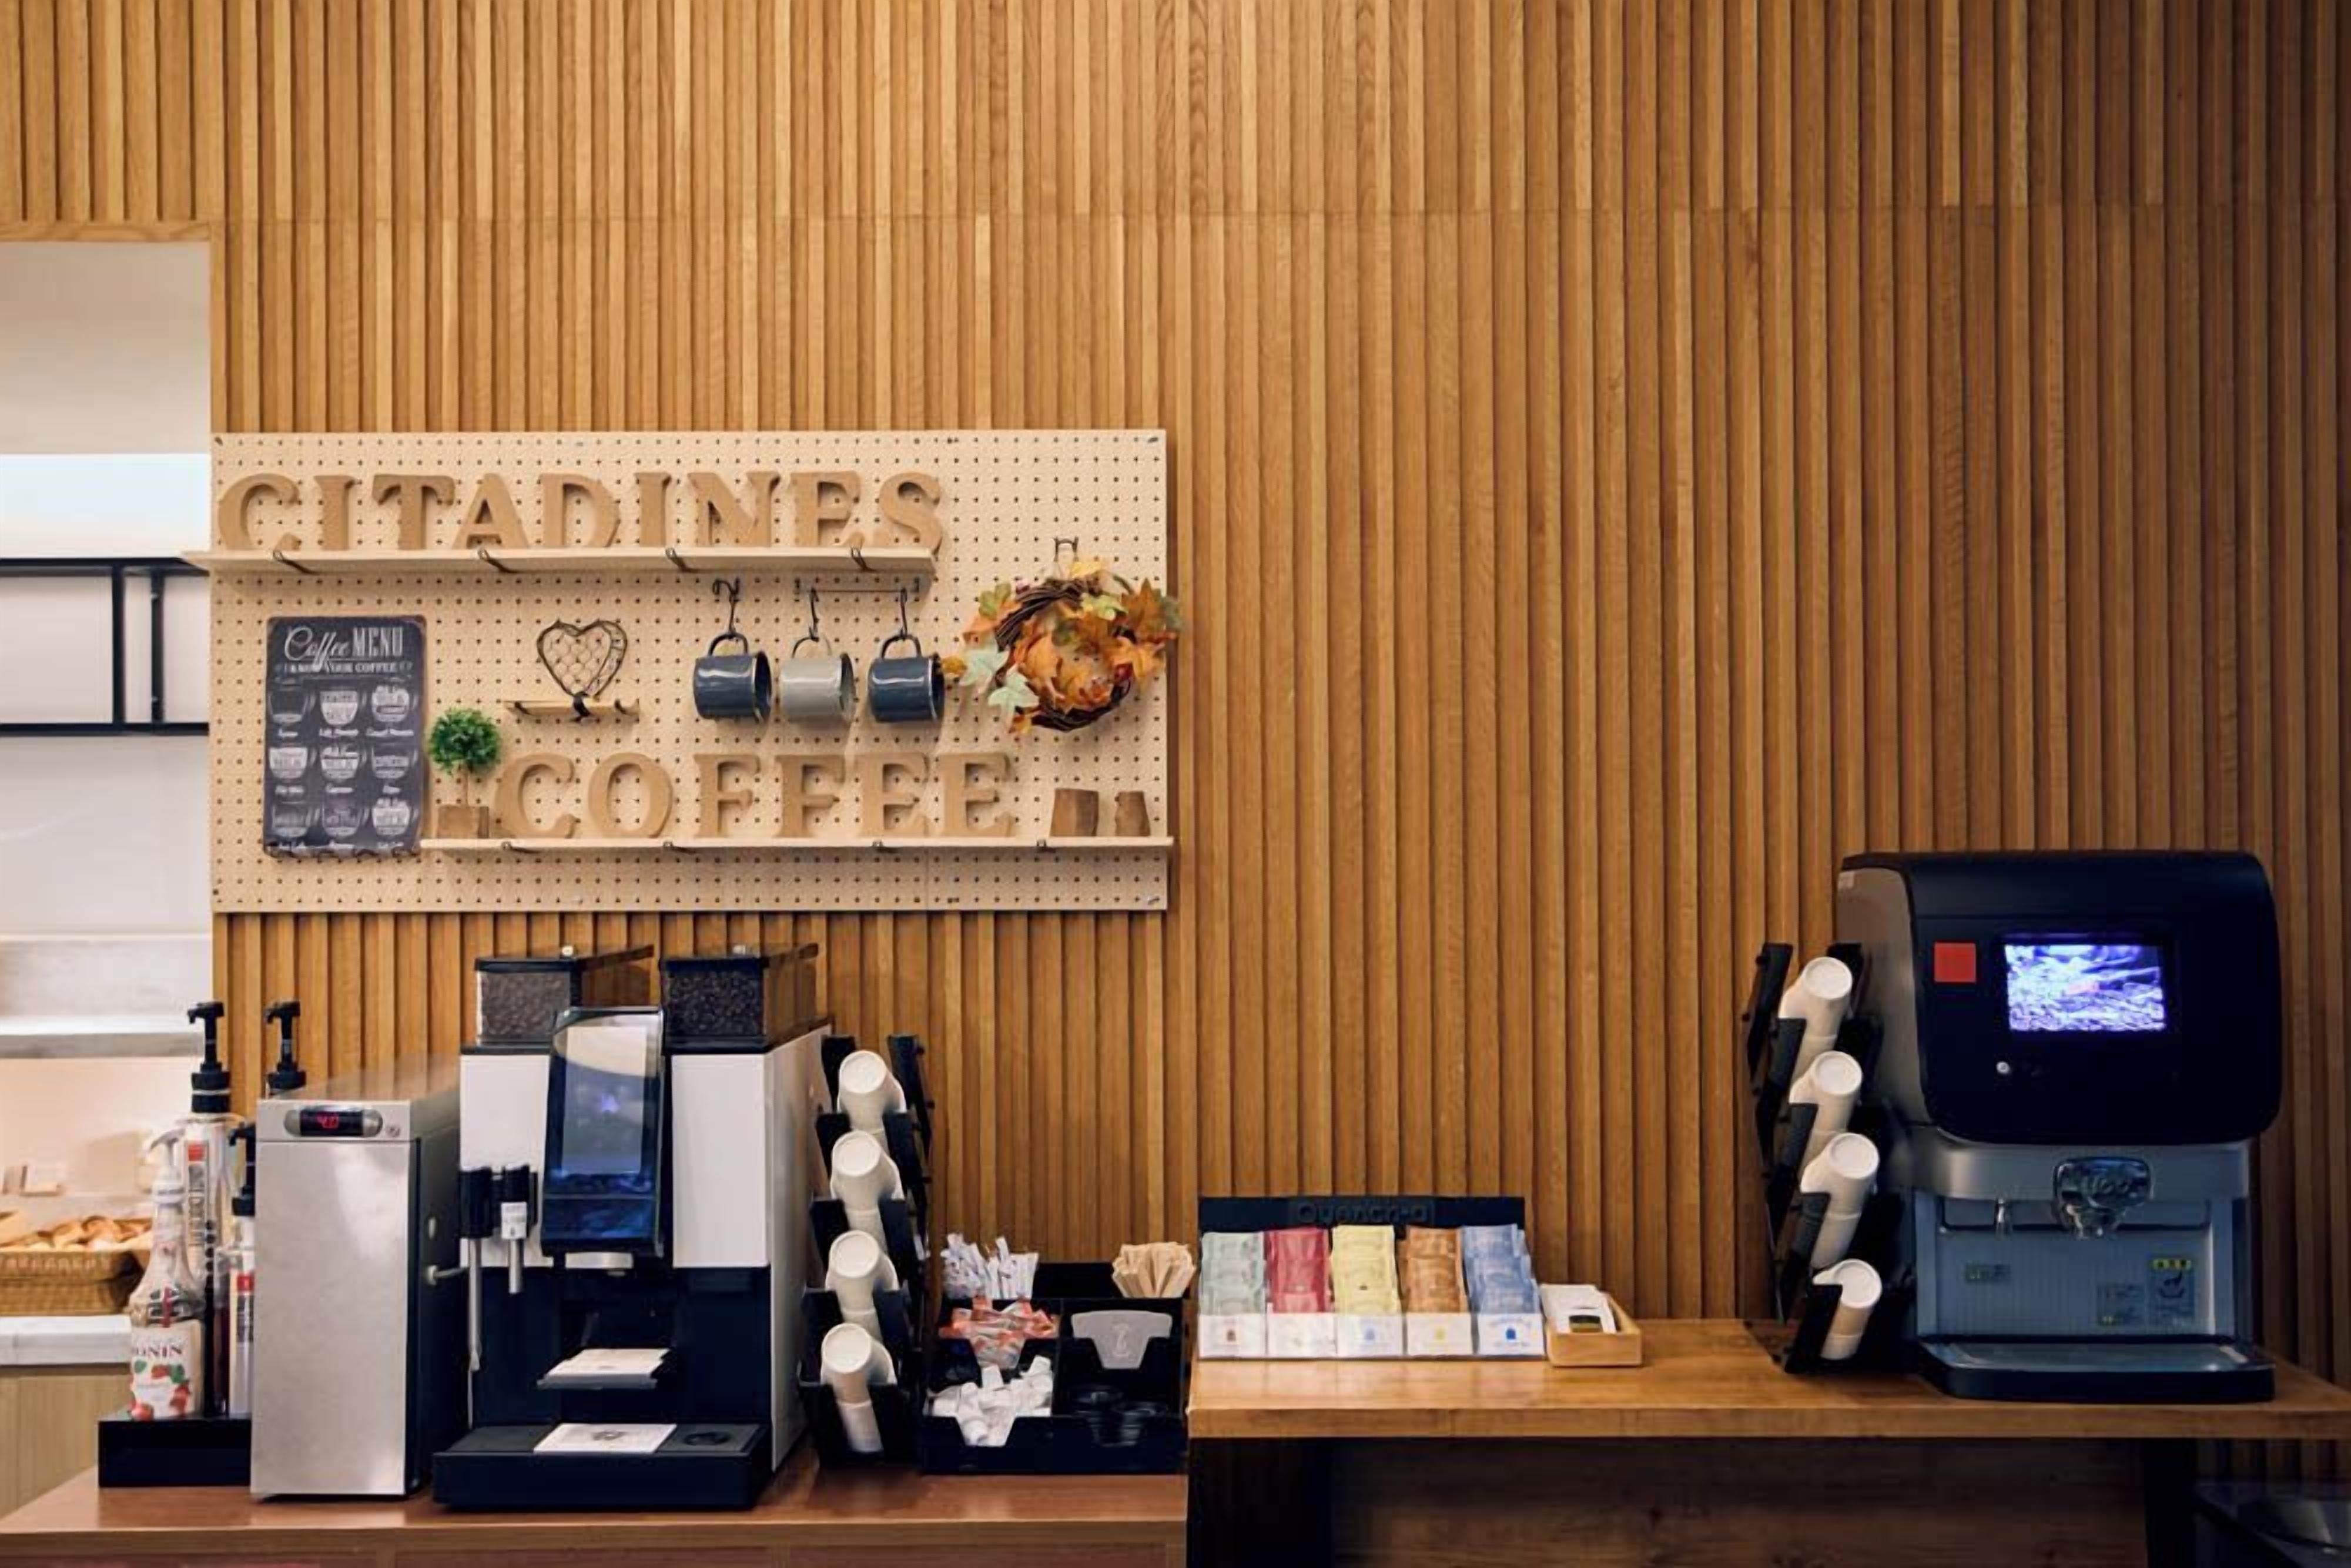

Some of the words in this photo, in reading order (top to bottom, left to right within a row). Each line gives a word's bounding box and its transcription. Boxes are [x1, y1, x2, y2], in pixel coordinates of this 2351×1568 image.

[217, 470, 943, 552] CITADINES
[285, 626, 349, 672] Coffee
[353, 626, 403, 657] MENU
[355, 662, 397, 673] COFFEE
[493, 752, 1018, 839] COFFEE
